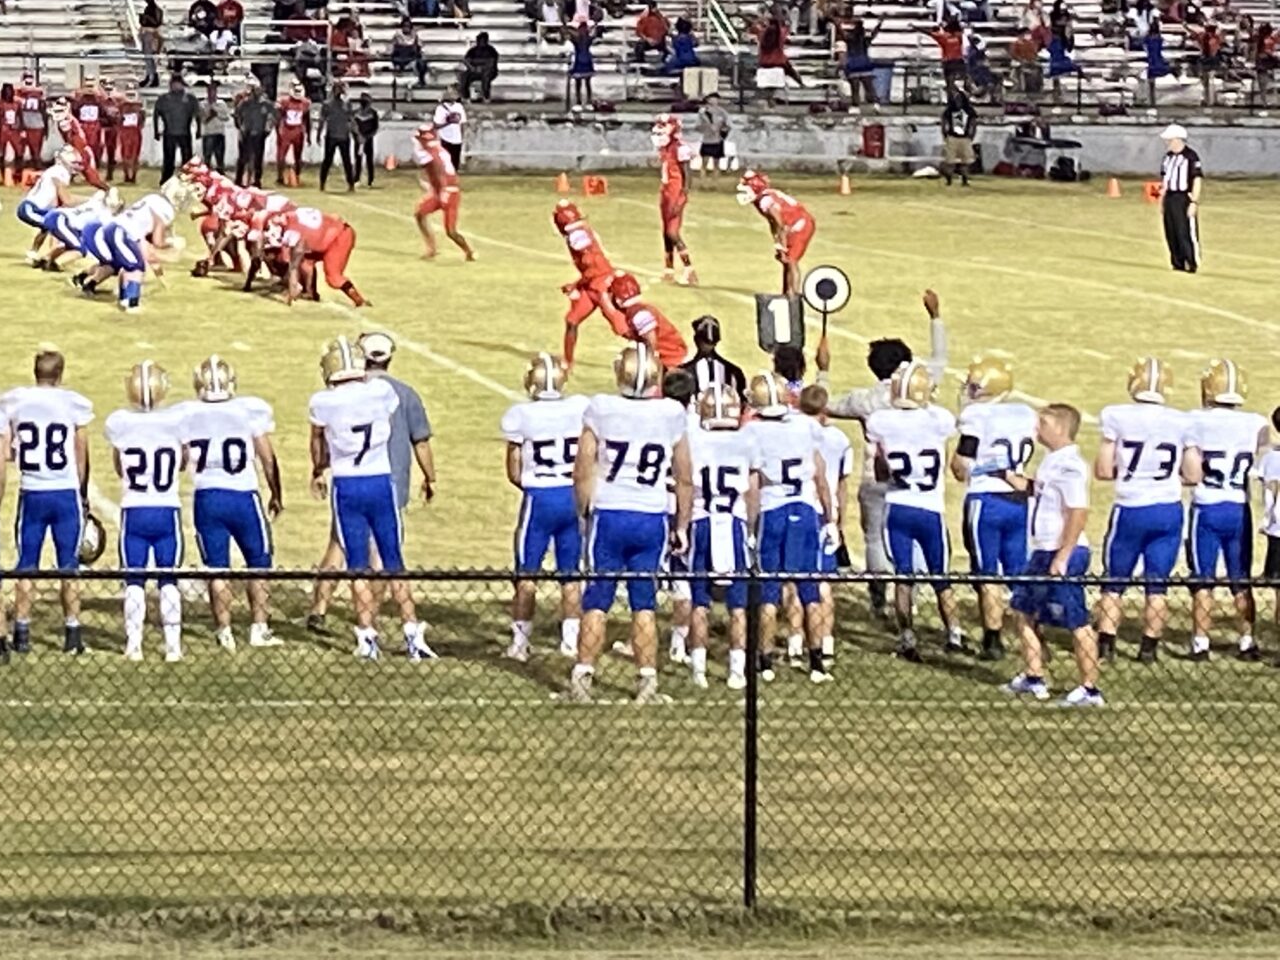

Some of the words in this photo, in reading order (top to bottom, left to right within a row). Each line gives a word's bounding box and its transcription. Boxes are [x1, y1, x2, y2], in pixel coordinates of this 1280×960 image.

[767, 298, 792, 344] 1
[17, 422, 68, 471] 28
[189, 437, 248, 474] 70
[352, 425, 372, 466] 7
[605, 441, 666, 487] 78
[1122, 440, 1177, 482] 73
[125, 446, 177, 494] 20
[701, 465, 740, 513] 15
[781, 458, 803, 497] 5
[888, 448, 941, 492] 23
[1202, 451, 1254, 489] 50
